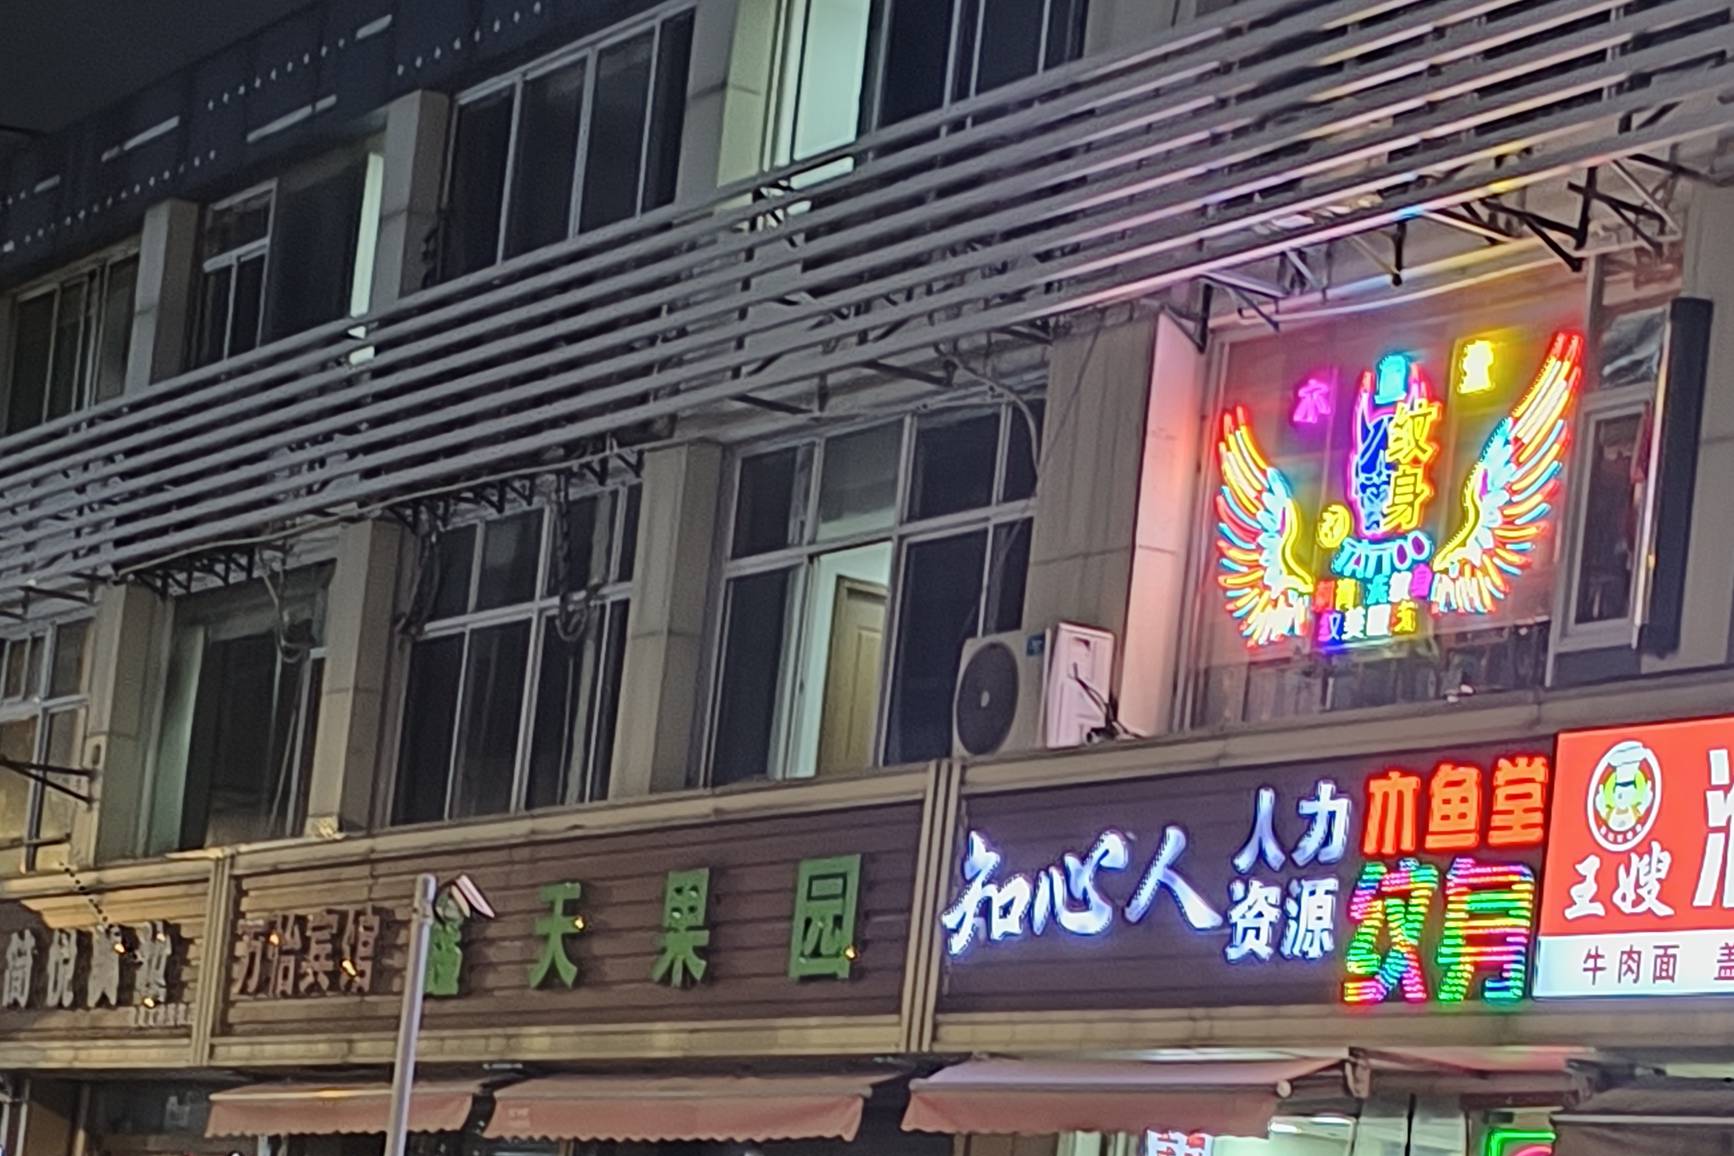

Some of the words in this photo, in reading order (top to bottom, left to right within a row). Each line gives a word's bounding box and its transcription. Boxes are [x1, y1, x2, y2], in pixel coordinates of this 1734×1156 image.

[1383, 397, 1440, 531] 纹身
[1331, 531, 1434, 578] TATTOO
[1232, 779, 1352, 873] 人力
[1361, 753, 1547, 855] 木鱼堂
[941, 828, 1224, 957] 知心人
[1223, 876, 1340, 963] 资源
[1563, 840, 1675, 921] 王嫂
[1343, 857, 1536, 1003] 纹身
[1582, 944, 1681, 987] 牛肉面
